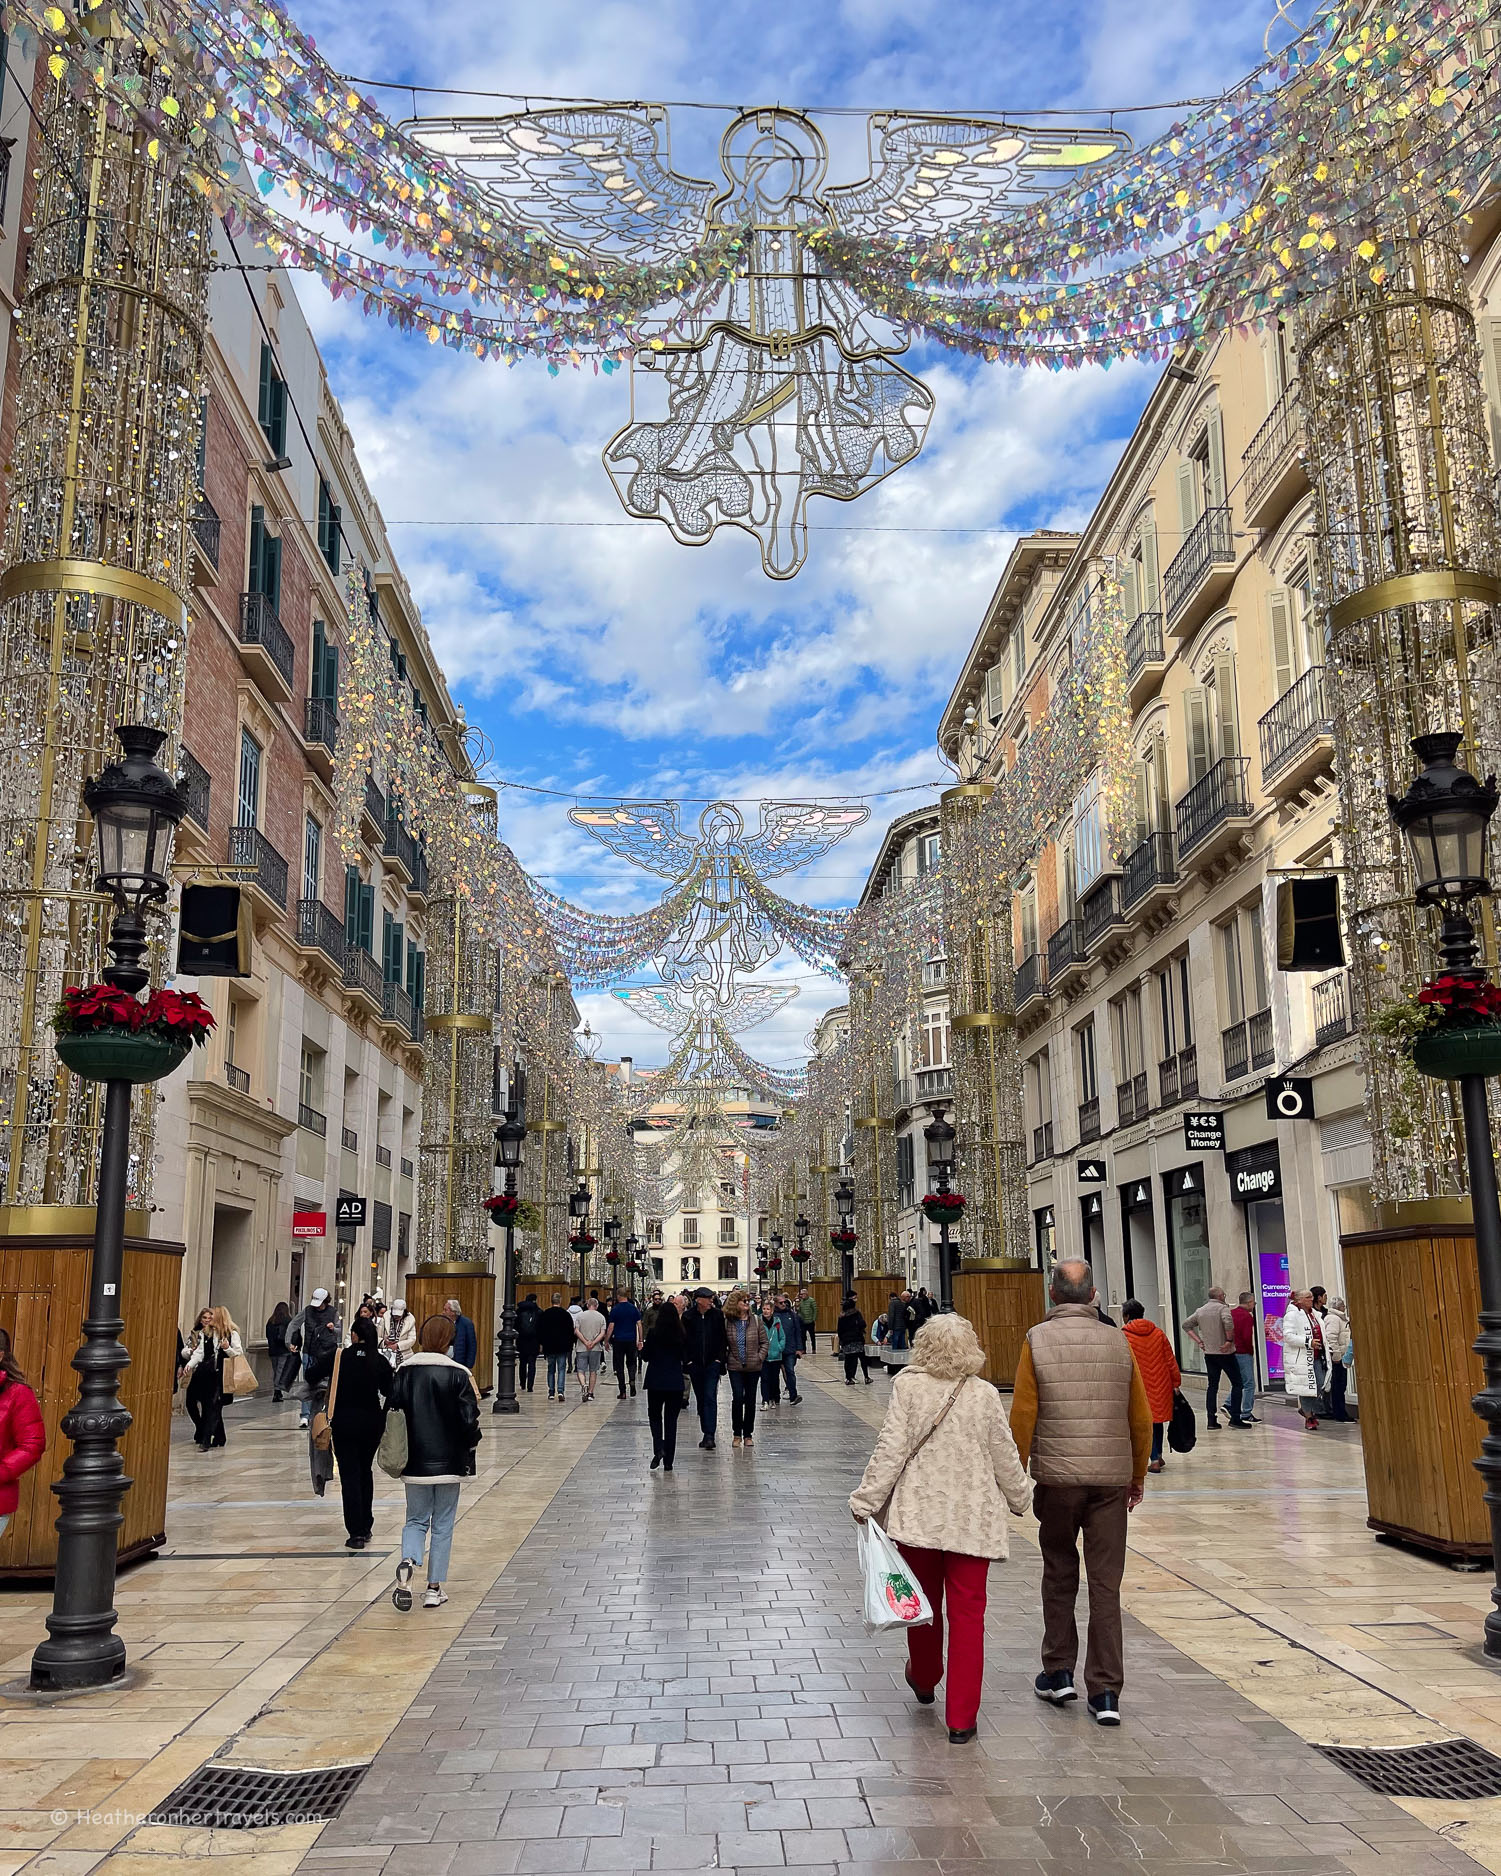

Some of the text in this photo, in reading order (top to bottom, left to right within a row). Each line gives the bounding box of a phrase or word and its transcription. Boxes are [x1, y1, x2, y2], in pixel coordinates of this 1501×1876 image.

[1187, 1130, 1222, 1140] Change
[1190, 1139, 1221, 1148] Money
[1236, 1169, 1275, 1192] Change
[340, 1203, 362, 1213] AD
[1307, 1368, 1316, 1390] PUSH
